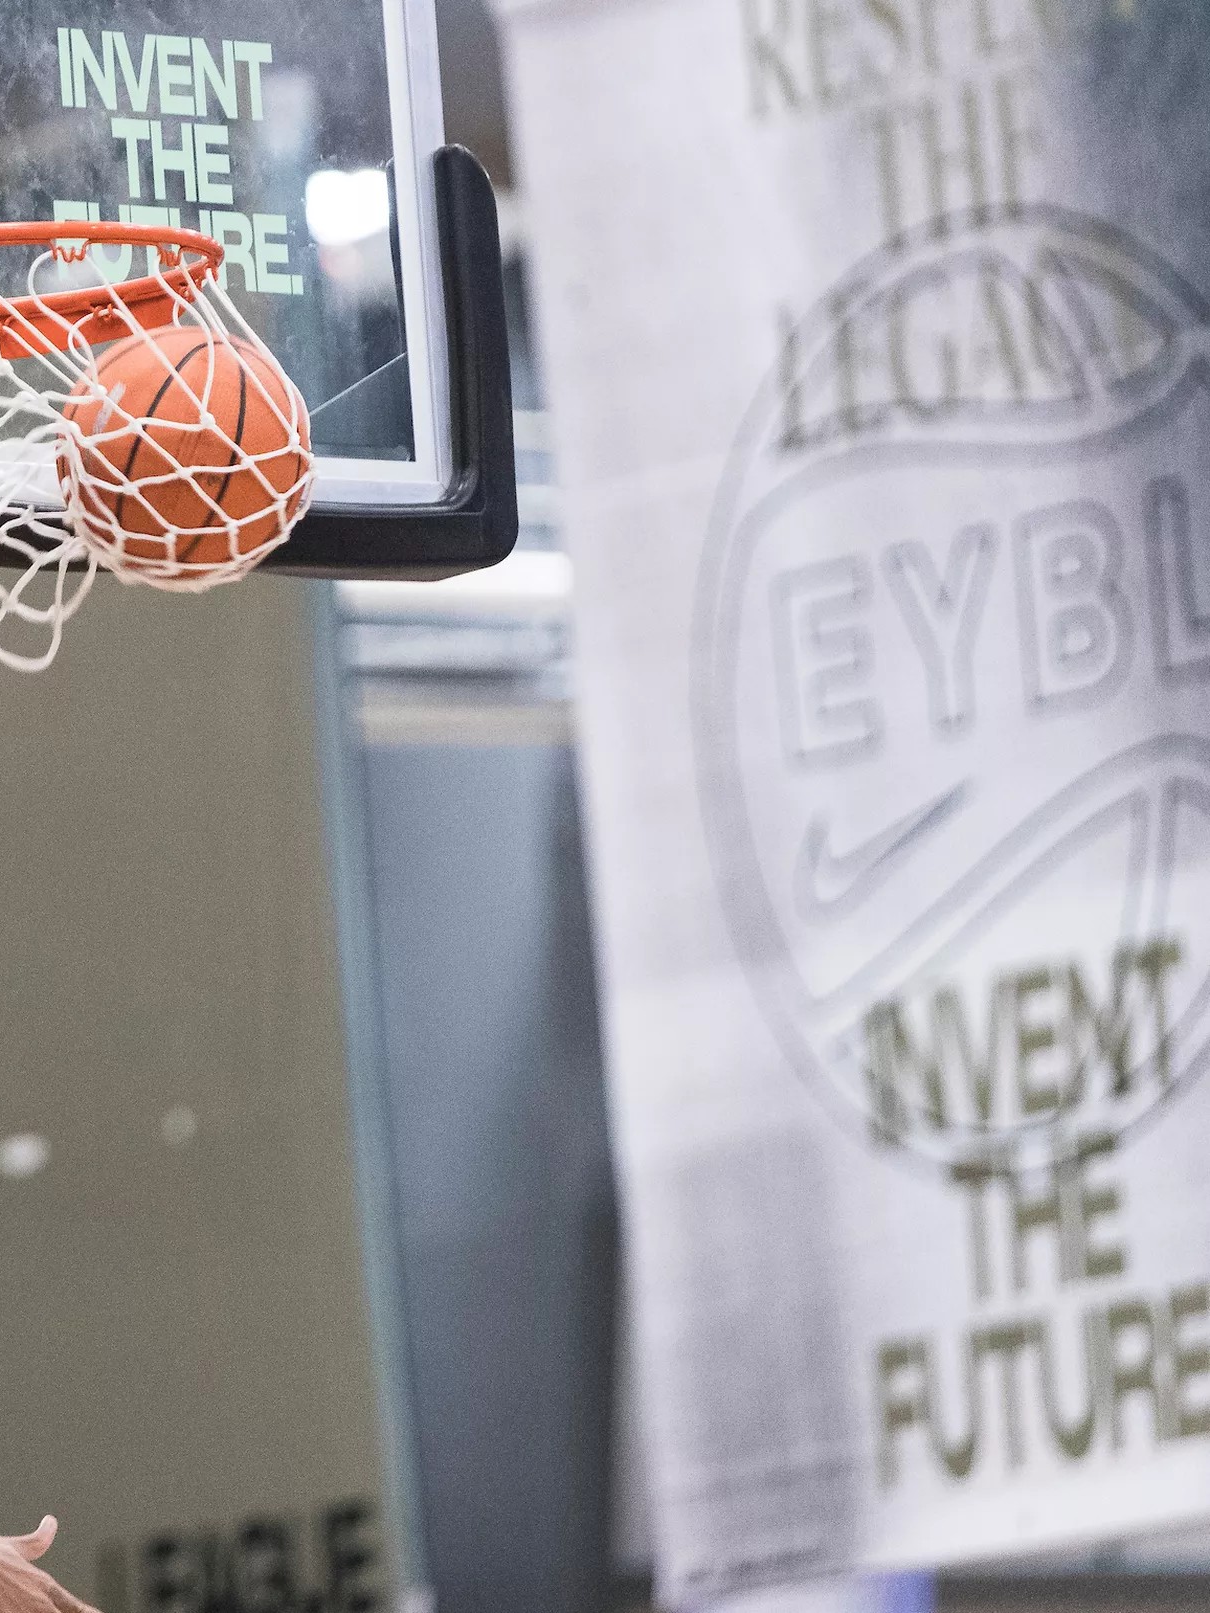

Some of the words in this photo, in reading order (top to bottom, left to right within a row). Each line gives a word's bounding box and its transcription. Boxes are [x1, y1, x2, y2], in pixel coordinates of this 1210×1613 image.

[57, 27, 273, 121] INVENT
[111, 117, 234, 205] THE
[770, 475, 1210, 775] EYBL
[862, 935, 1183, 1152] INVENT
[950, 1128, 1127, 1305] THE
[875, 1283, 1210, 1492] FUTURE
